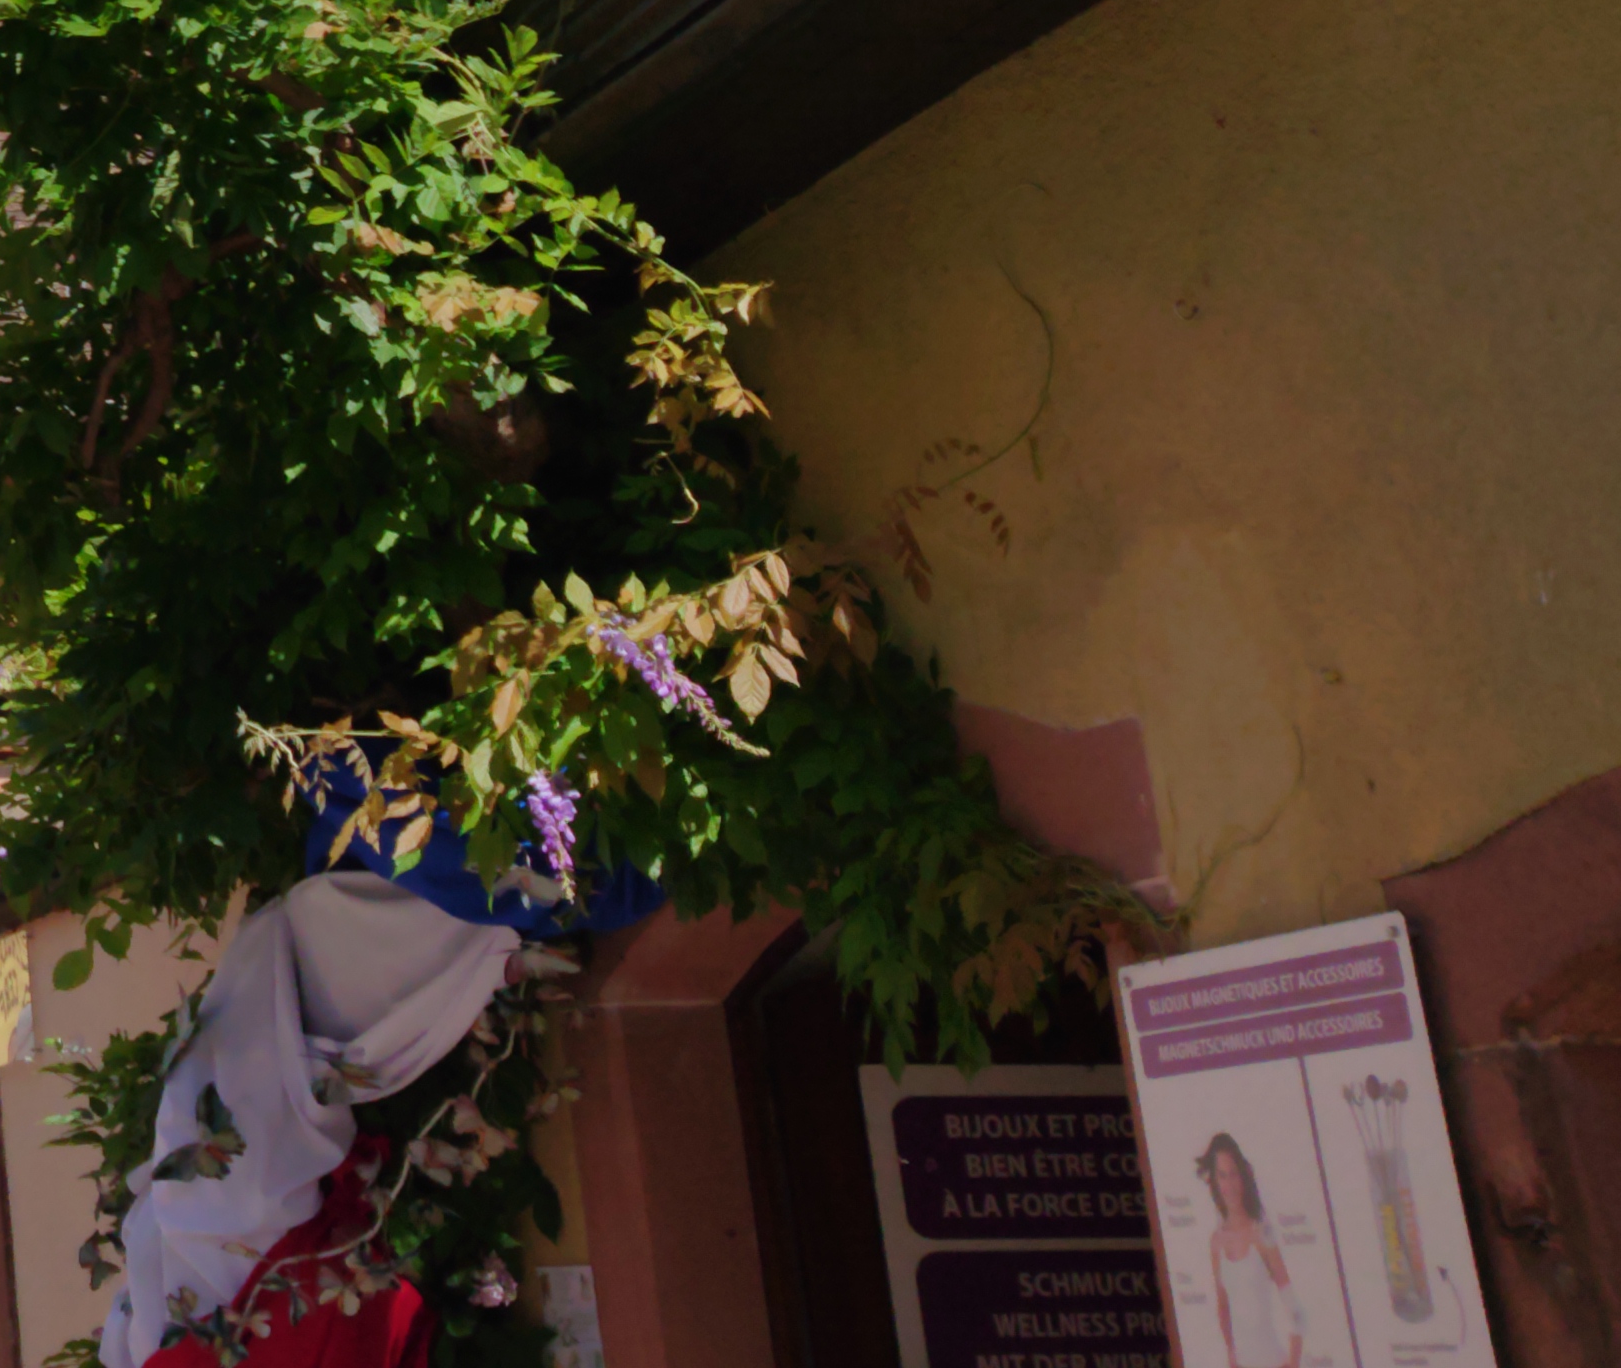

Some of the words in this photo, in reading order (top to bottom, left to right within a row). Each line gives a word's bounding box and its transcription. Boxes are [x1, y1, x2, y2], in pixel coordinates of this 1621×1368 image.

[1148, 992, 1190, 1017] BIJOUX
[1278, 973, 1295, 992] ET
[1298, 957, 1385, 990] ACCESSOIRES
[1158, 1029, 1266, 1063] MAGNETSCHMUCK
[1267, 1023, 1296, 1047] UND
[1298, 1010, 1384, 1041] ACCESSOIRES
[945, 1113, 1043, 1139] BIJOUX
[1046, 1114, 1077, 1138] ET
[965, 1153, 1028, 1178] BIEN
[1033, 1147, 1098, 1177] ÊTRE
[942, 1188, 961, 1218] À
[966, 1193, 1002, 1218] LA
[1006, 1192, 1094, 1218] FORCE
[1018, 1272, 1150, 1297] SCHMUCK
[993, 1312, 1120, 1338] WELLNESS
